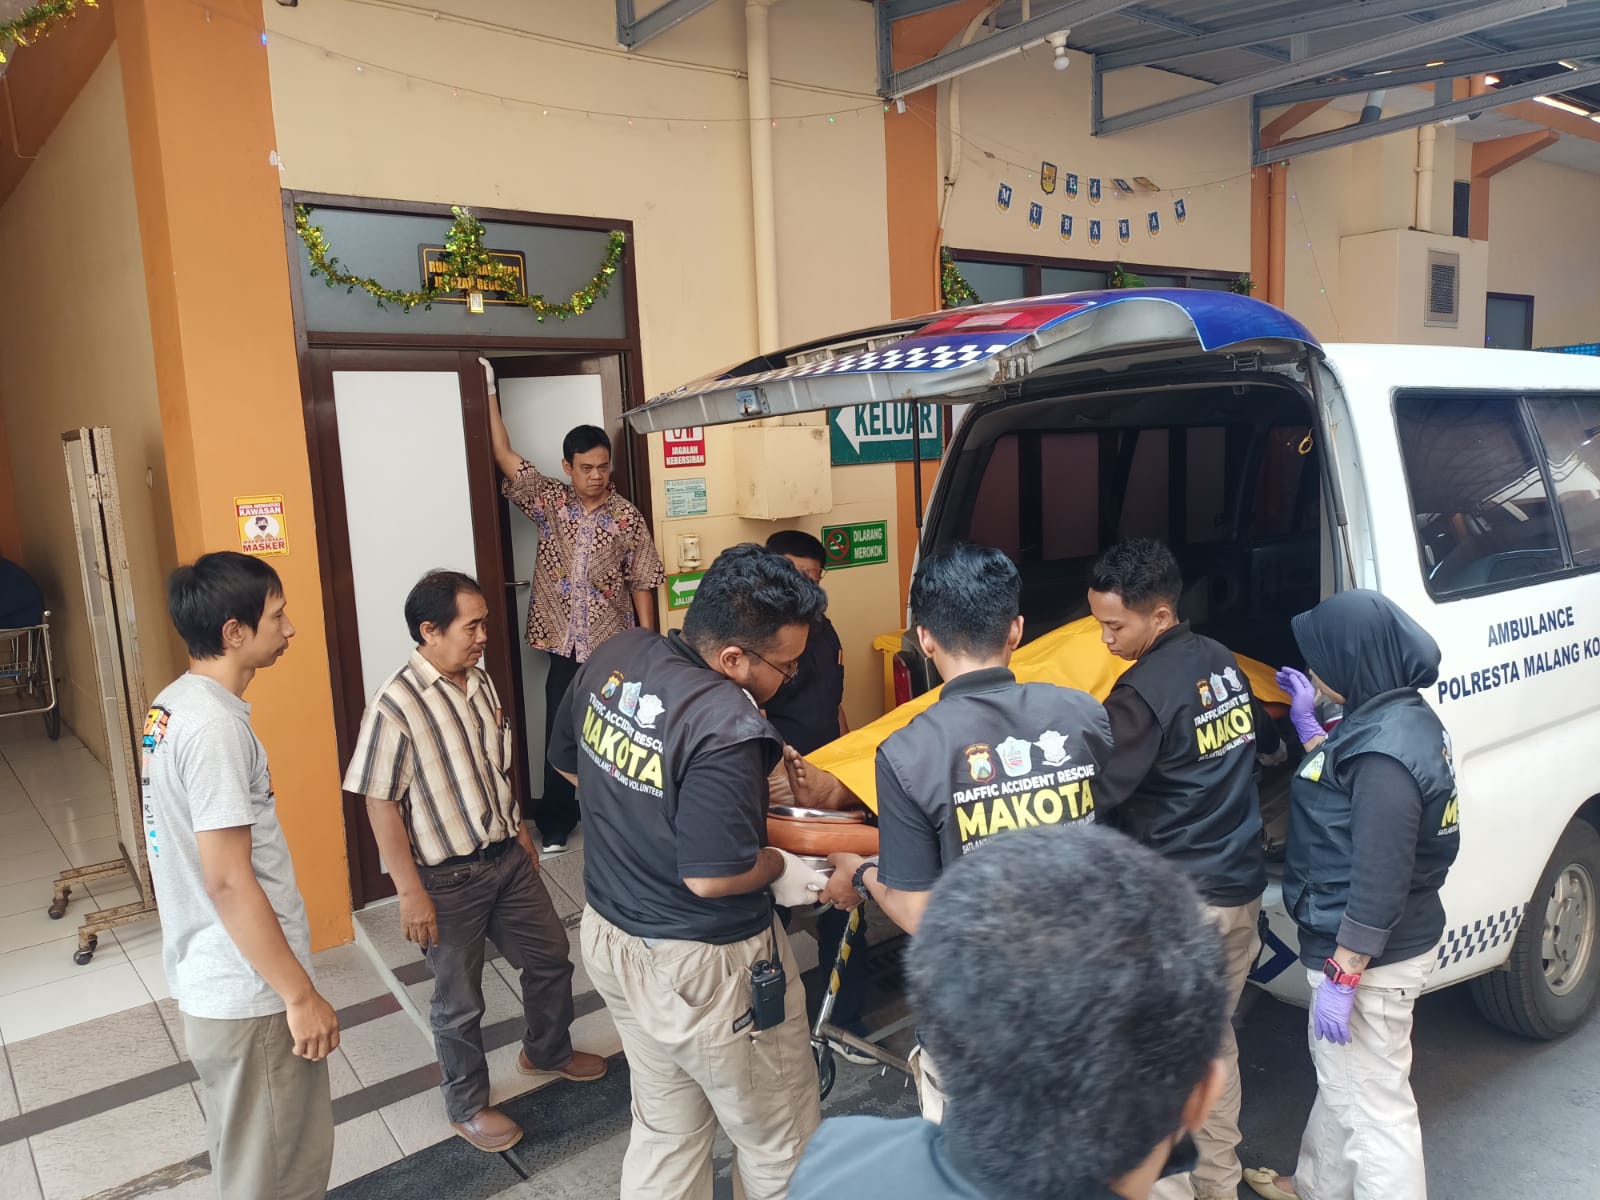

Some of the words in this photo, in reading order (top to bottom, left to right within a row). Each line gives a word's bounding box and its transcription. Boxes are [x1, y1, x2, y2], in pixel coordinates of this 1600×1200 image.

[1001, 189, 1184, 236] MUBARAK
[666, 455, 704, 465] KEBERSIHAN
[240, 506, 281, 516] KAWASAN
[243, 541, 285, 552] MASKER
[853, 528, 882, 542] DILARANG
[854, 545, 882, 559] MEROKOK
[1488, 606, 1574, 647] AMBULANCE
[1438, 660, 1520, 704] POLRESTA
[1524, 643, 1580, 678] MALANG
[1584, 637, 1600, 660] KO
[634, 731, 663, 756] RESCU
[1196, 704, 1253, 754] MAKOT
[583, 705, 663, 789] MAKOTA
[628, 779, 664, 798] VOLUNTEER
[953, 784, 999, 805] TRAFFIC
[1001, 773, 1054, 795] ACCIDENT
[1057, 764, 1095, 783] RESCUE
[956, 779, 1094, 842] MAKOTA
